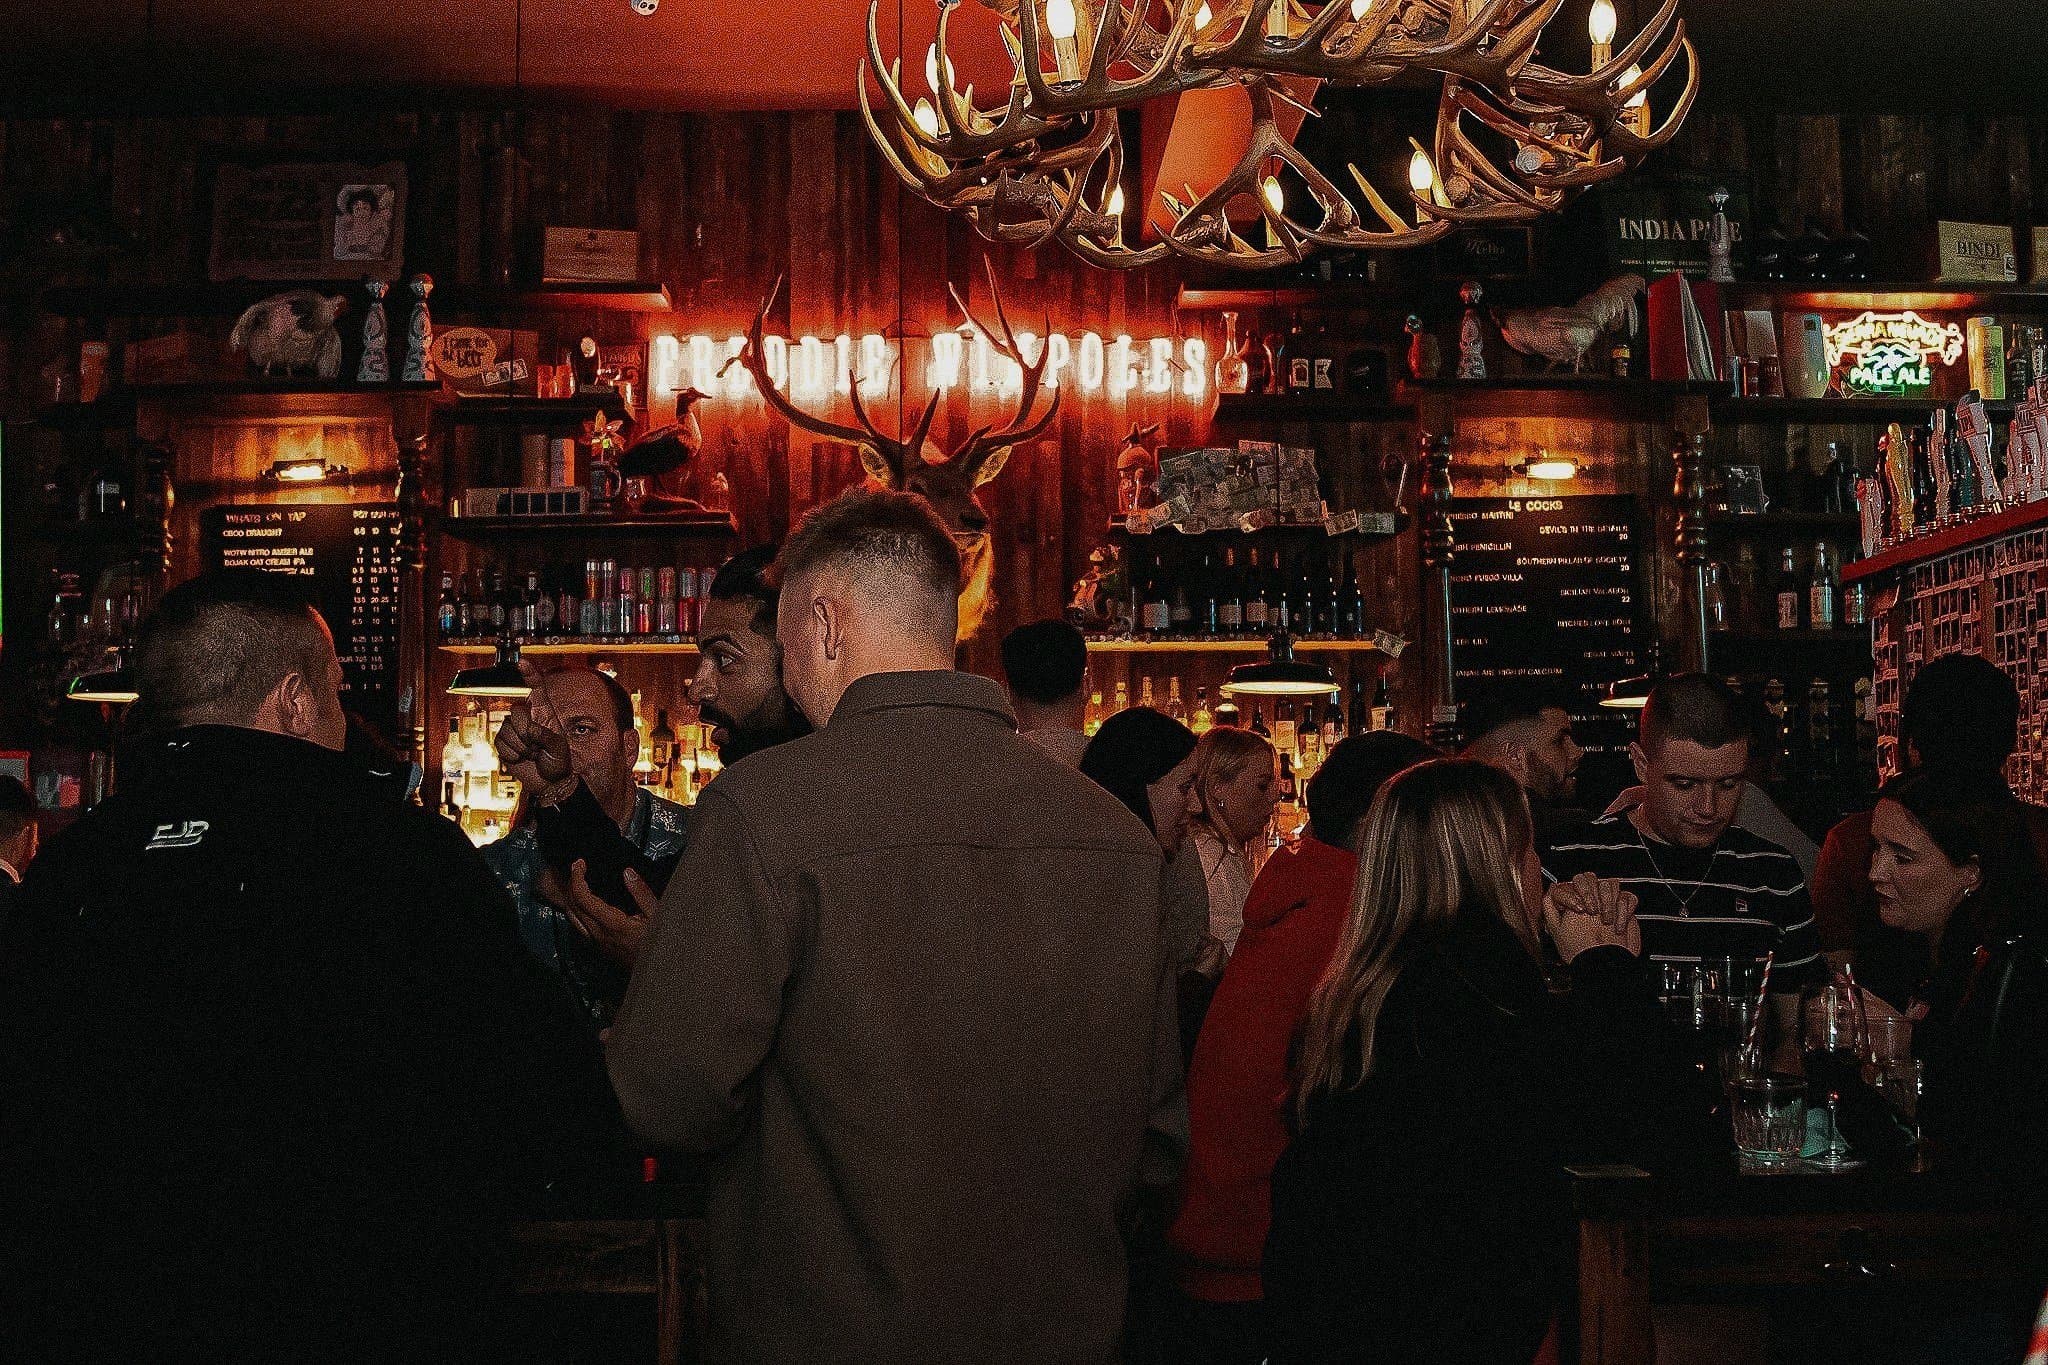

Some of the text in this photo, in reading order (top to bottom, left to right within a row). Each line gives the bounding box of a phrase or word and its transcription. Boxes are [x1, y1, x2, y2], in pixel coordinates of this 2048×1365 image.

[1618, 216, 1743, 242] INDIA PE
[1957, 241, 2000, 258] BINDI
[655, 334, 886, 397] FREDDIE
[1895, 367, 1931, 385] ALE
[1525, 500, 1563, 511] COCKS
[288, 511, 306, 521] TAP
[1481, 511, 1514, 520] MARTINI
[246, 527, 283, 537] DRAUGHT
[271, 547, 298, 556] AMBER
[299, 547, 314, 556] ALE
[1471, 542, 1512, 551] PENICILLIN
[250, 558, 264, 566] OAT
[265, 558, 291, 566] CREAM
[293, 557, 306, 566] IPA
[1516, 556, 1557, 566] SOUTHERN
[299, 567, 315, 575] ALE
[1502, 573, 1524, 582] VILLA
[1486, 604, 1527, 614] LEMONADE
